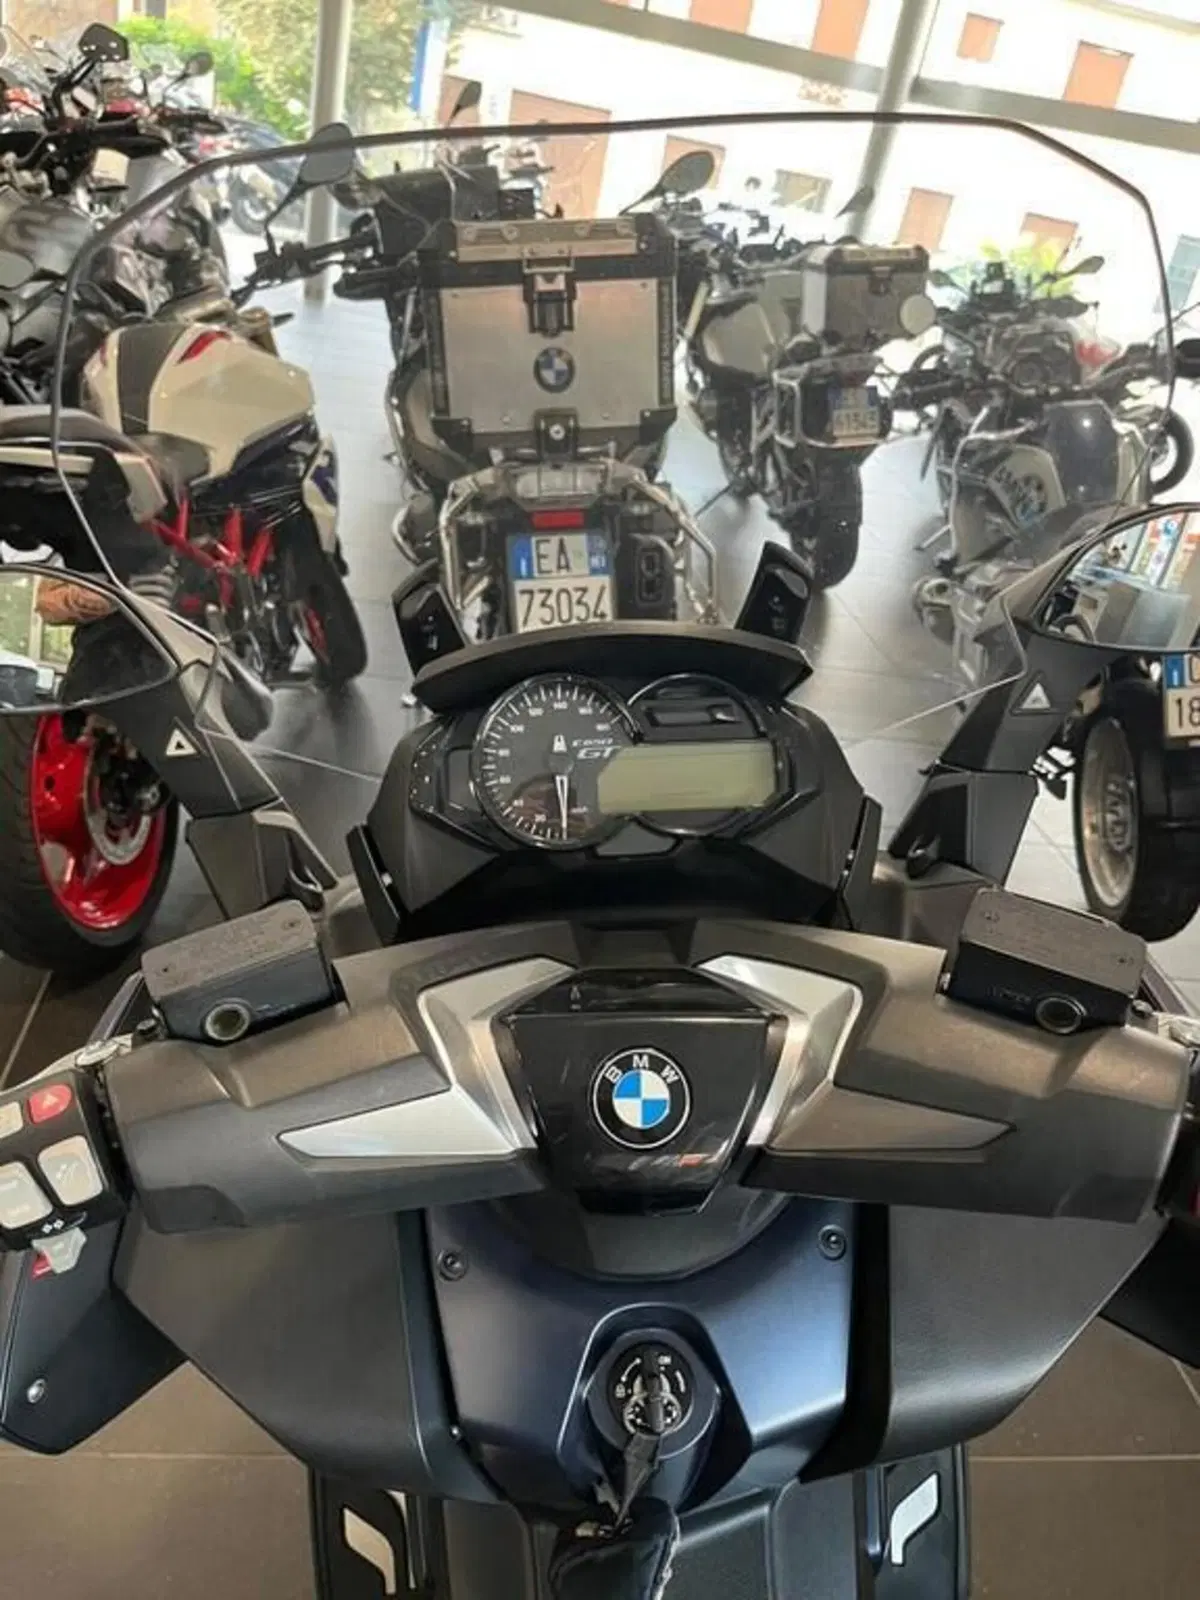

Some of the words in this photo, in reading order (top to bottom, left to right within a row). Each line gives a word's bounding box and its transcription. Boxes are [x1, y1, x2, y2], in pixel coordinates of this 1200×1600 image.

[536, 537, 571, 574] EA
[518, 584, 606, 627] 73034
[1176, 697, 1200, 729] 18
[577, 745, 621, 759] GT
[604, 1053, 681, 1085] BMW
